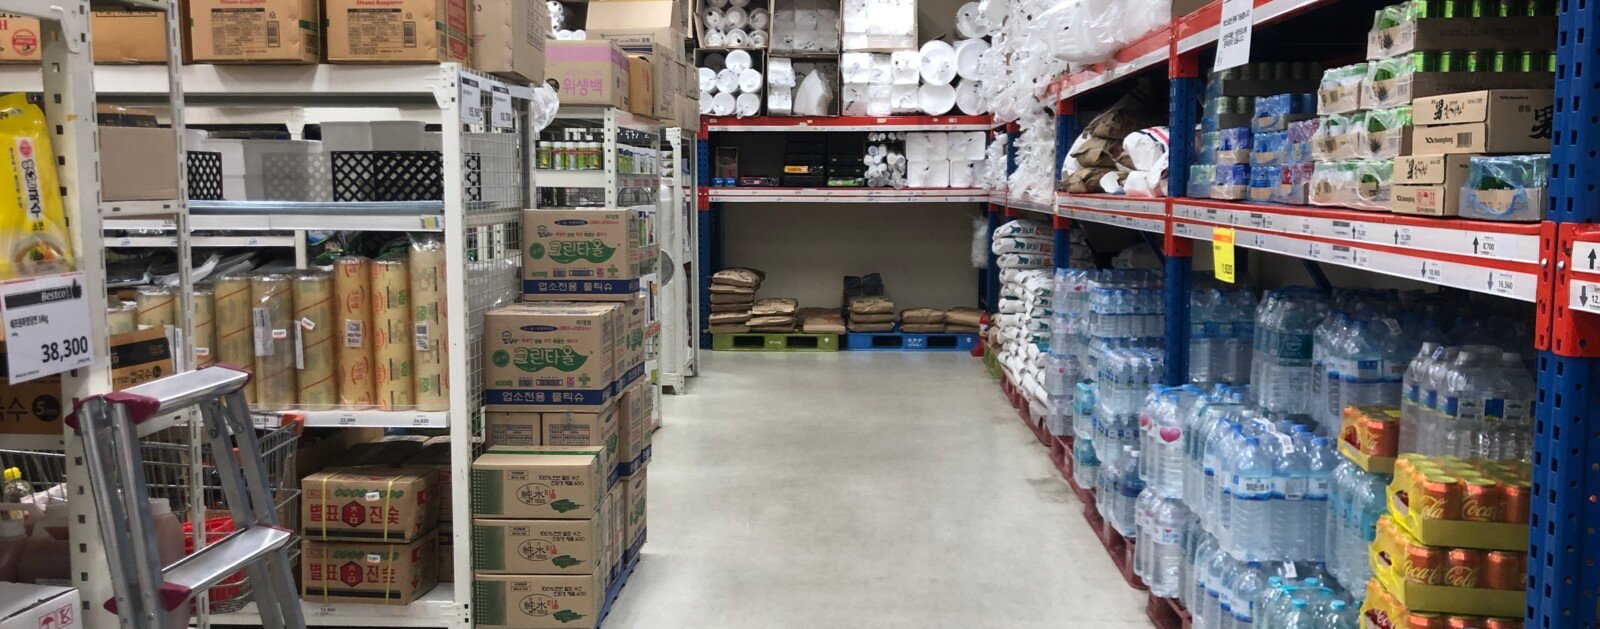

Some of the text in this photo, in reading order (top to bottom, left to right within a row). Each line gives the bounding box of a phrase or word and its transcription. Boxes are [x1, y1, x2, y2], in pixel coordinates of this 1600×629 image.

[562, 78, 602, 96] 위생백
[32, 222, 44, 231] 소면
[548, 239, 604, 257] 크린타올
[41, 291, 65, 301] Bestco
[539, 282, 612, 292] 업소전용 물티슈
[42, 336, 88, 363] 38,300
[514, 346, 574, 365] 크린타올
[502, 392, 584, 402] 업소전용 물티슈
[0, 398, 27, 422] 수
[310, 504, 339, 522] 별표
[370, 506, 399, 524] 진숯
[310, 563, 337, 580] 별표
